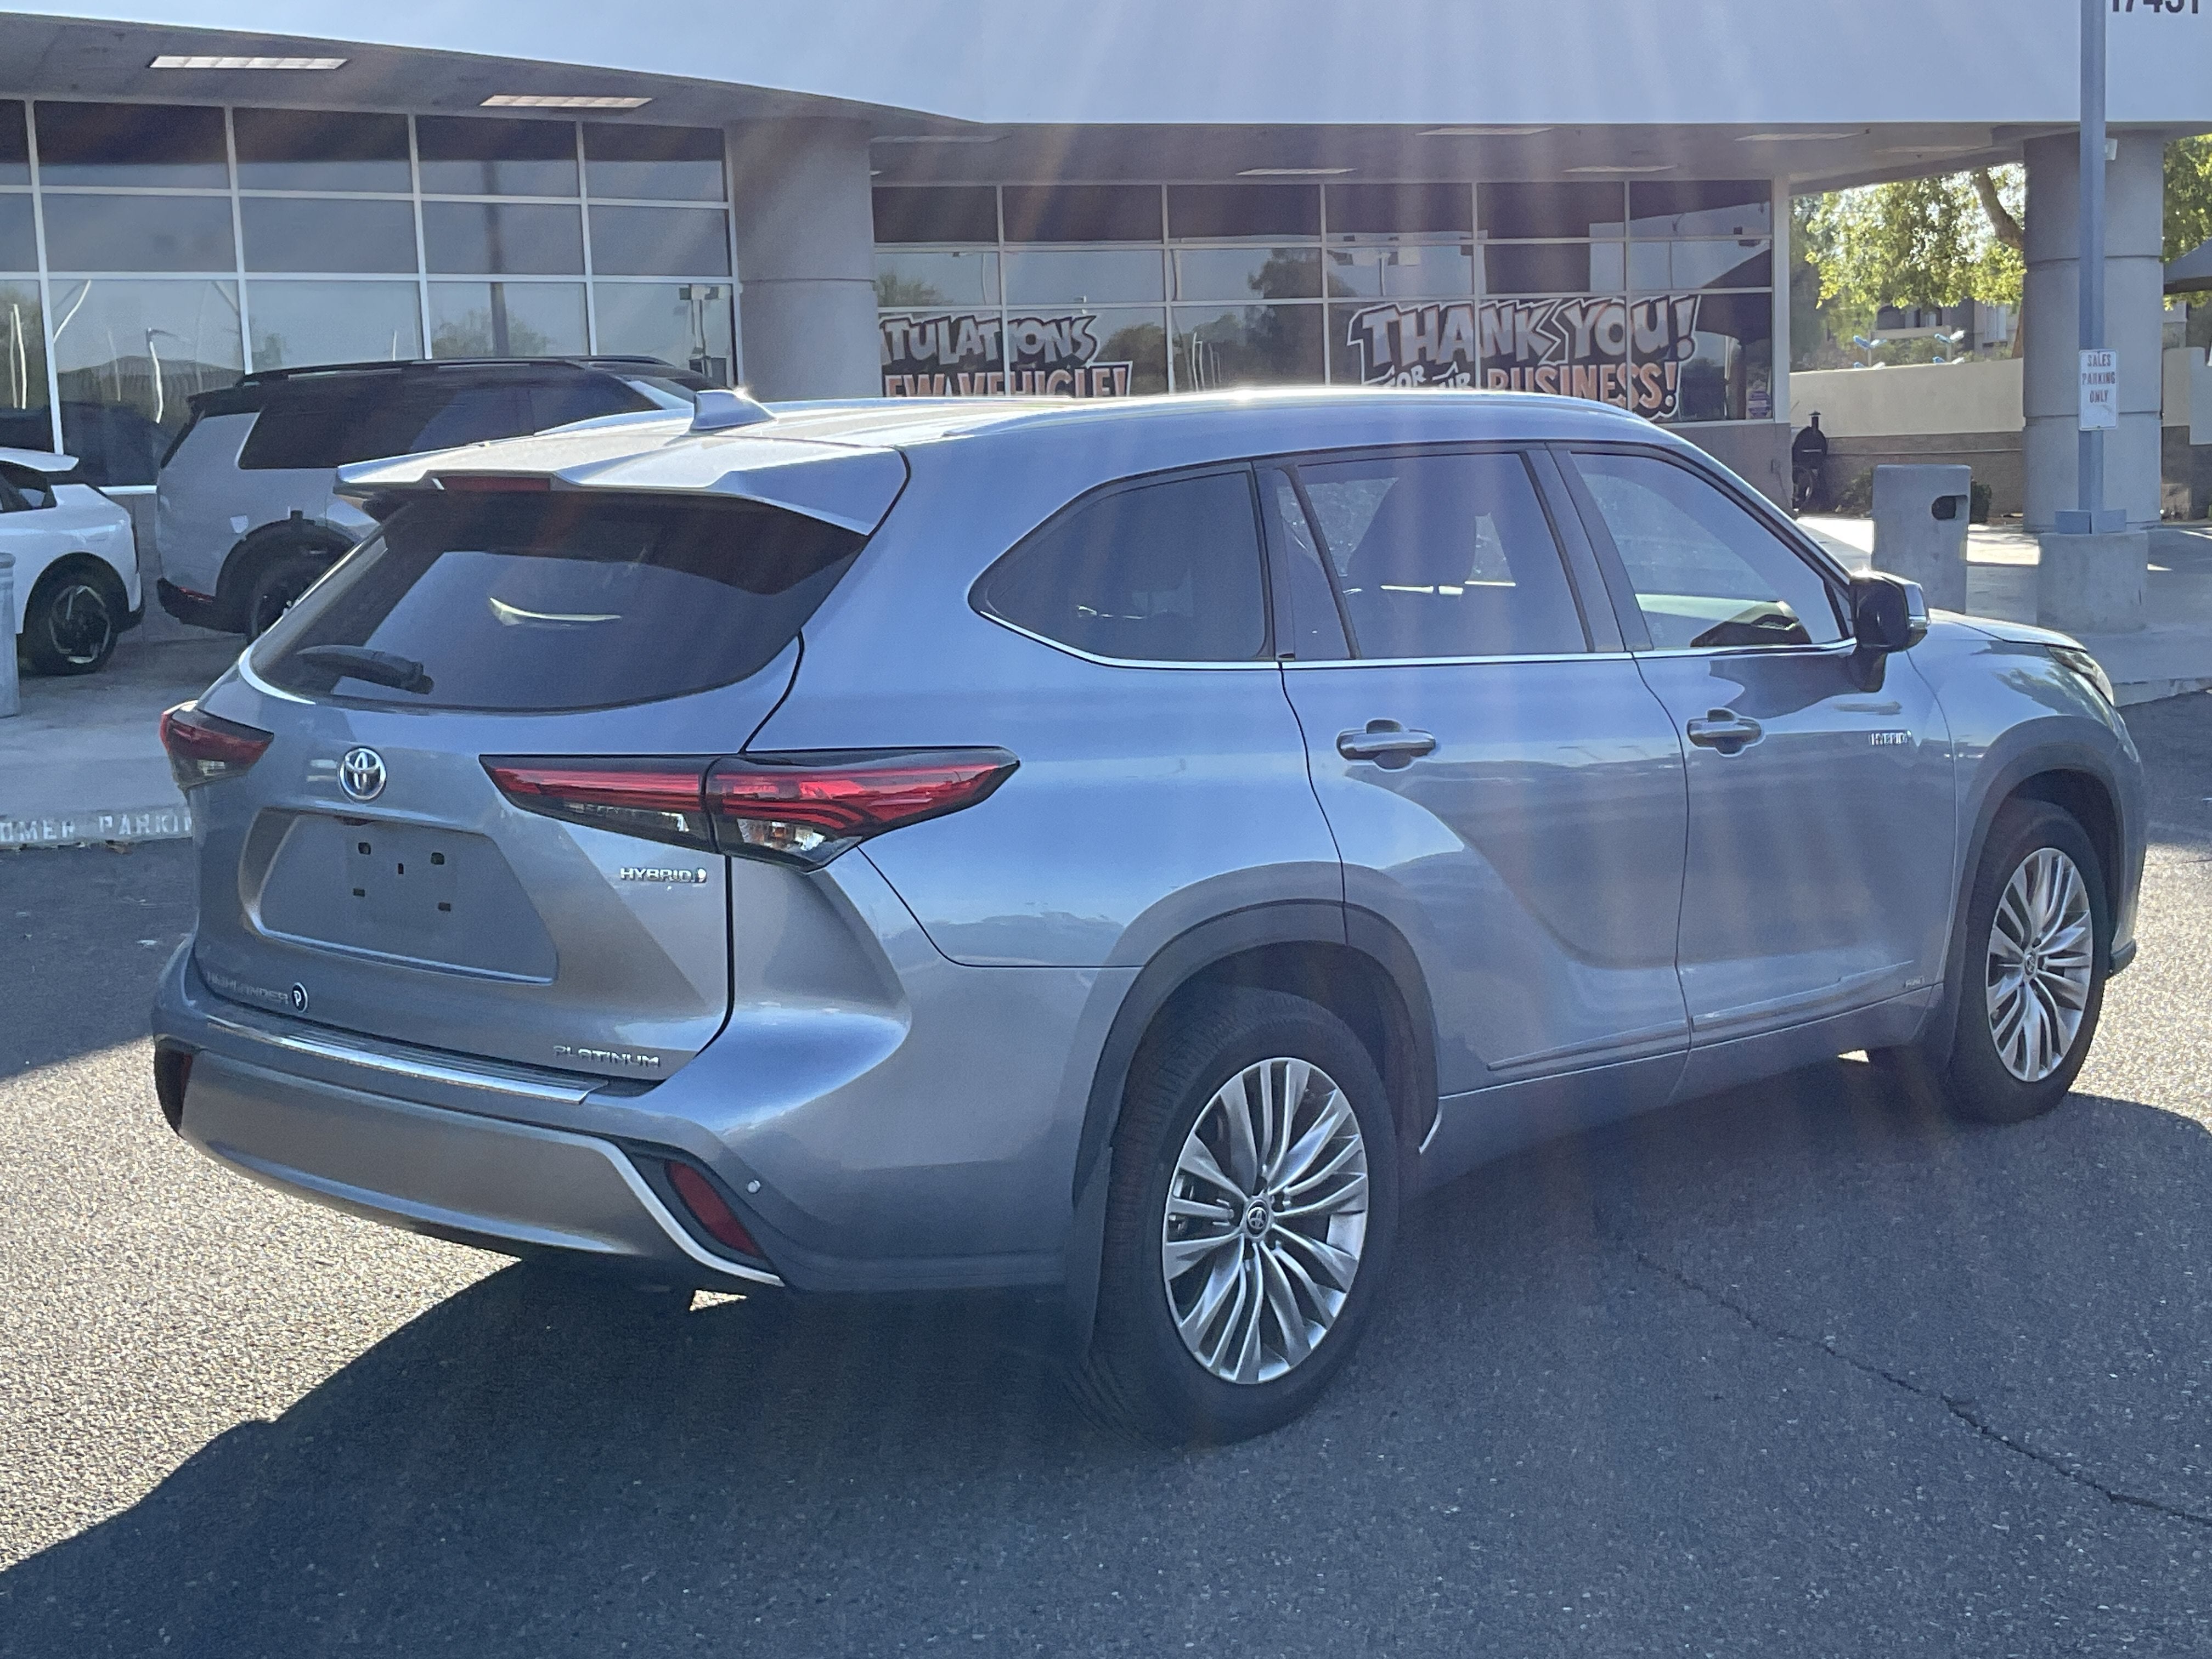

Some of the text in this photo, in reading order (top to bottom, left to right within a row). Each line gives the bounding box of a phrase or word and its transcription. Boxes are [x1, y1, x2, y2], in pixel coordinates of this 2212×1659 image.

[1362, 297, 1694, 366] THANK YOU!
[2087, 354, 2111, 367] SALES
[2082, 371, 2115, 385] PARKING
[2089, 390, 2108, 403] ONLY
[620, 867, 693, 882] HYBRID
[553, 1045, 660, 1066] PLATINUM
